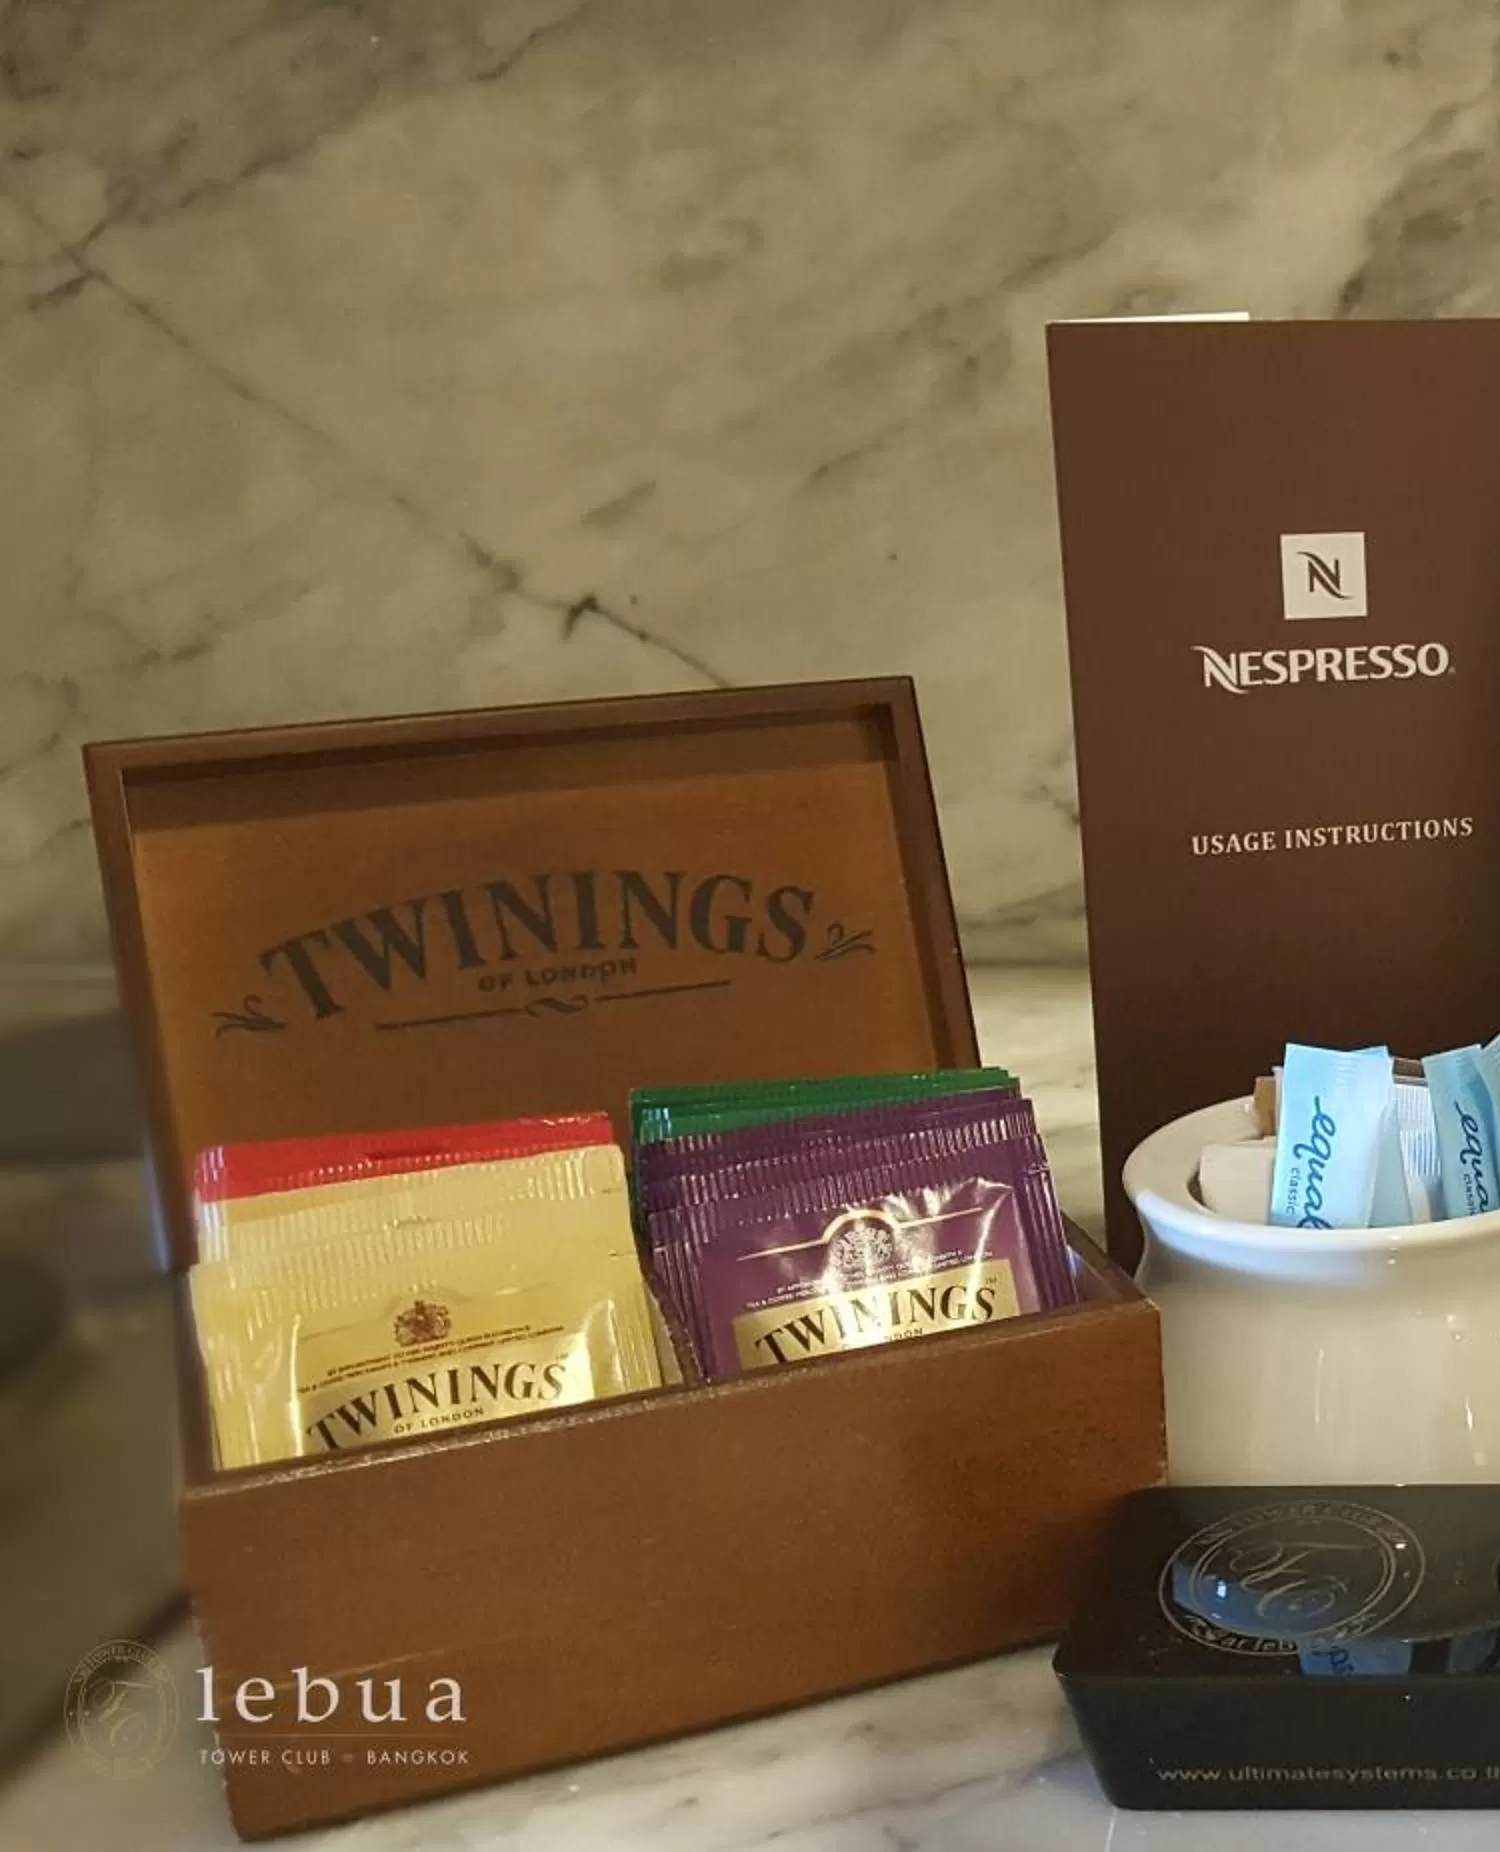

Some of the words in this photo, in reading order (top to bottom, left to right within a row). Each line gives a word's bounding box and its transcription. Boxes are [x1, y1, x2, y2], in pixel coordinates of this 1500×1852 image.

[1192, 643, 1450, 694] NESPRESSO
[1191, 831, 1276, 856] USAGE
[1284, 816, 1474, 849] INSTRUCTIONS
[257, 869, 814, 1020] TWININGS
[477, 973, 513, 993] OF
[524, 956, 638, 986] LONDON
[306, 1361, 567, 1450] TWININGS
[393, 1422, 413, 1435] OF
[420, 1407, 484, 1429] LONDON
